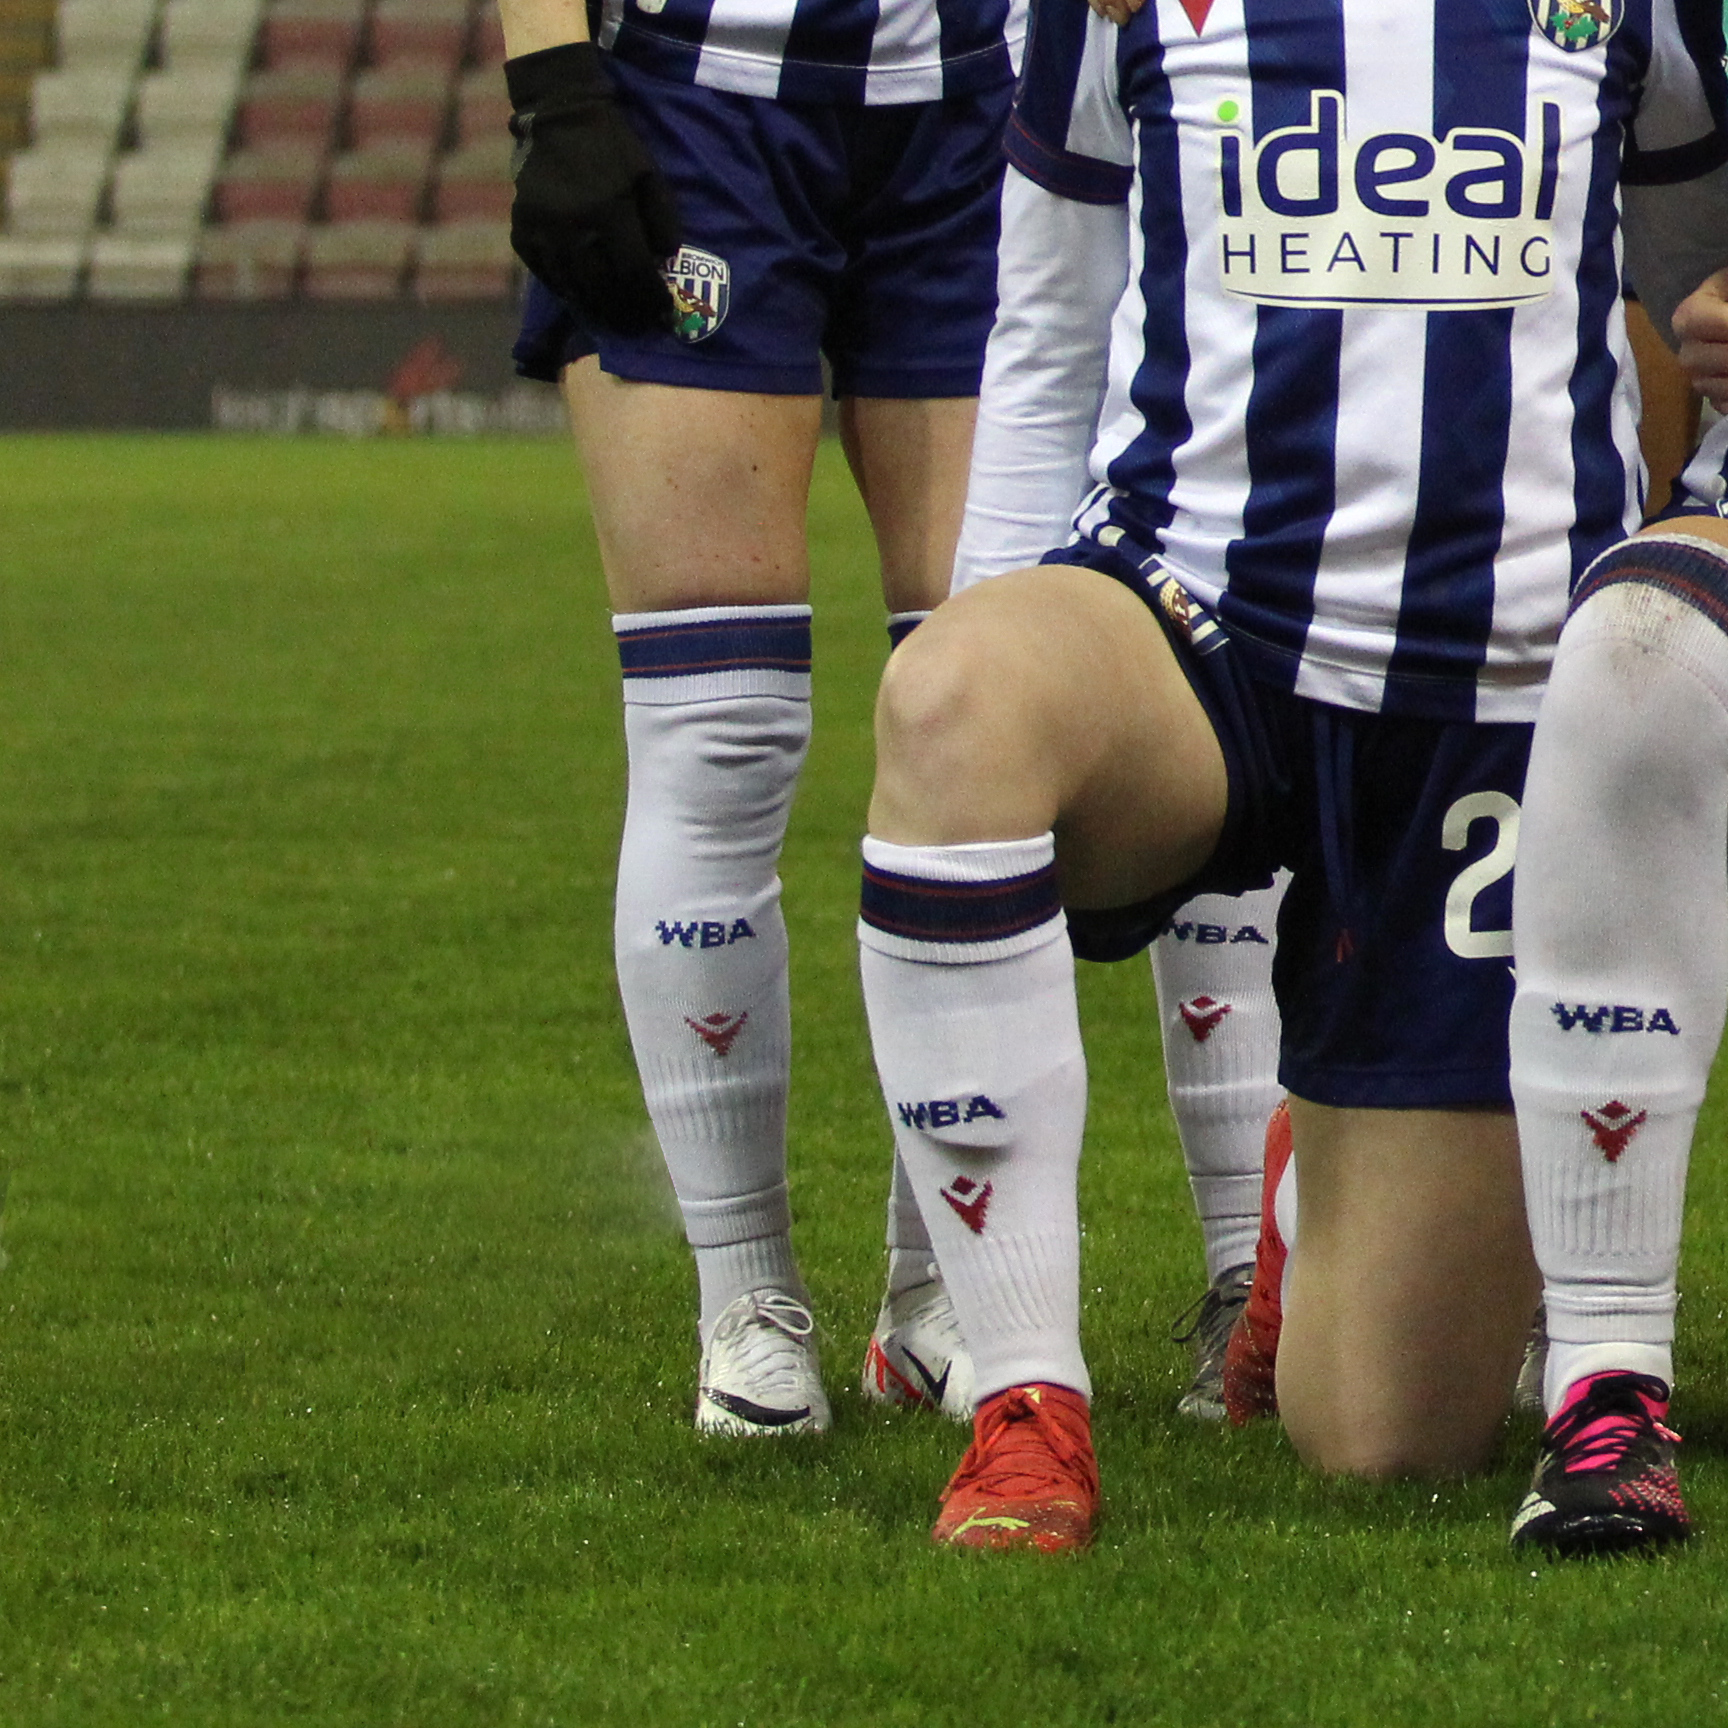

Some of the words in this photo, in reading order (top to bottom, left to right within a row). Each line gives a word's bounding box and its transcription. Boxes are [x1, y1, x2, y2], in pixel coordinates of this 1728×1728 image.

[1215, 92, 1562, 221] ideal
[670, 260, 725, 281] LBION
[1222, 232, 1553, 278] HEATING
[1441, 790, 1522, 959] 2
[654, 916, 757, 950] WBA
[1161, 921, 1269, 944] WBA
[1552, 1002, 1681, 1036] WBA
[898, 1093, 1006, 1129] WBA
